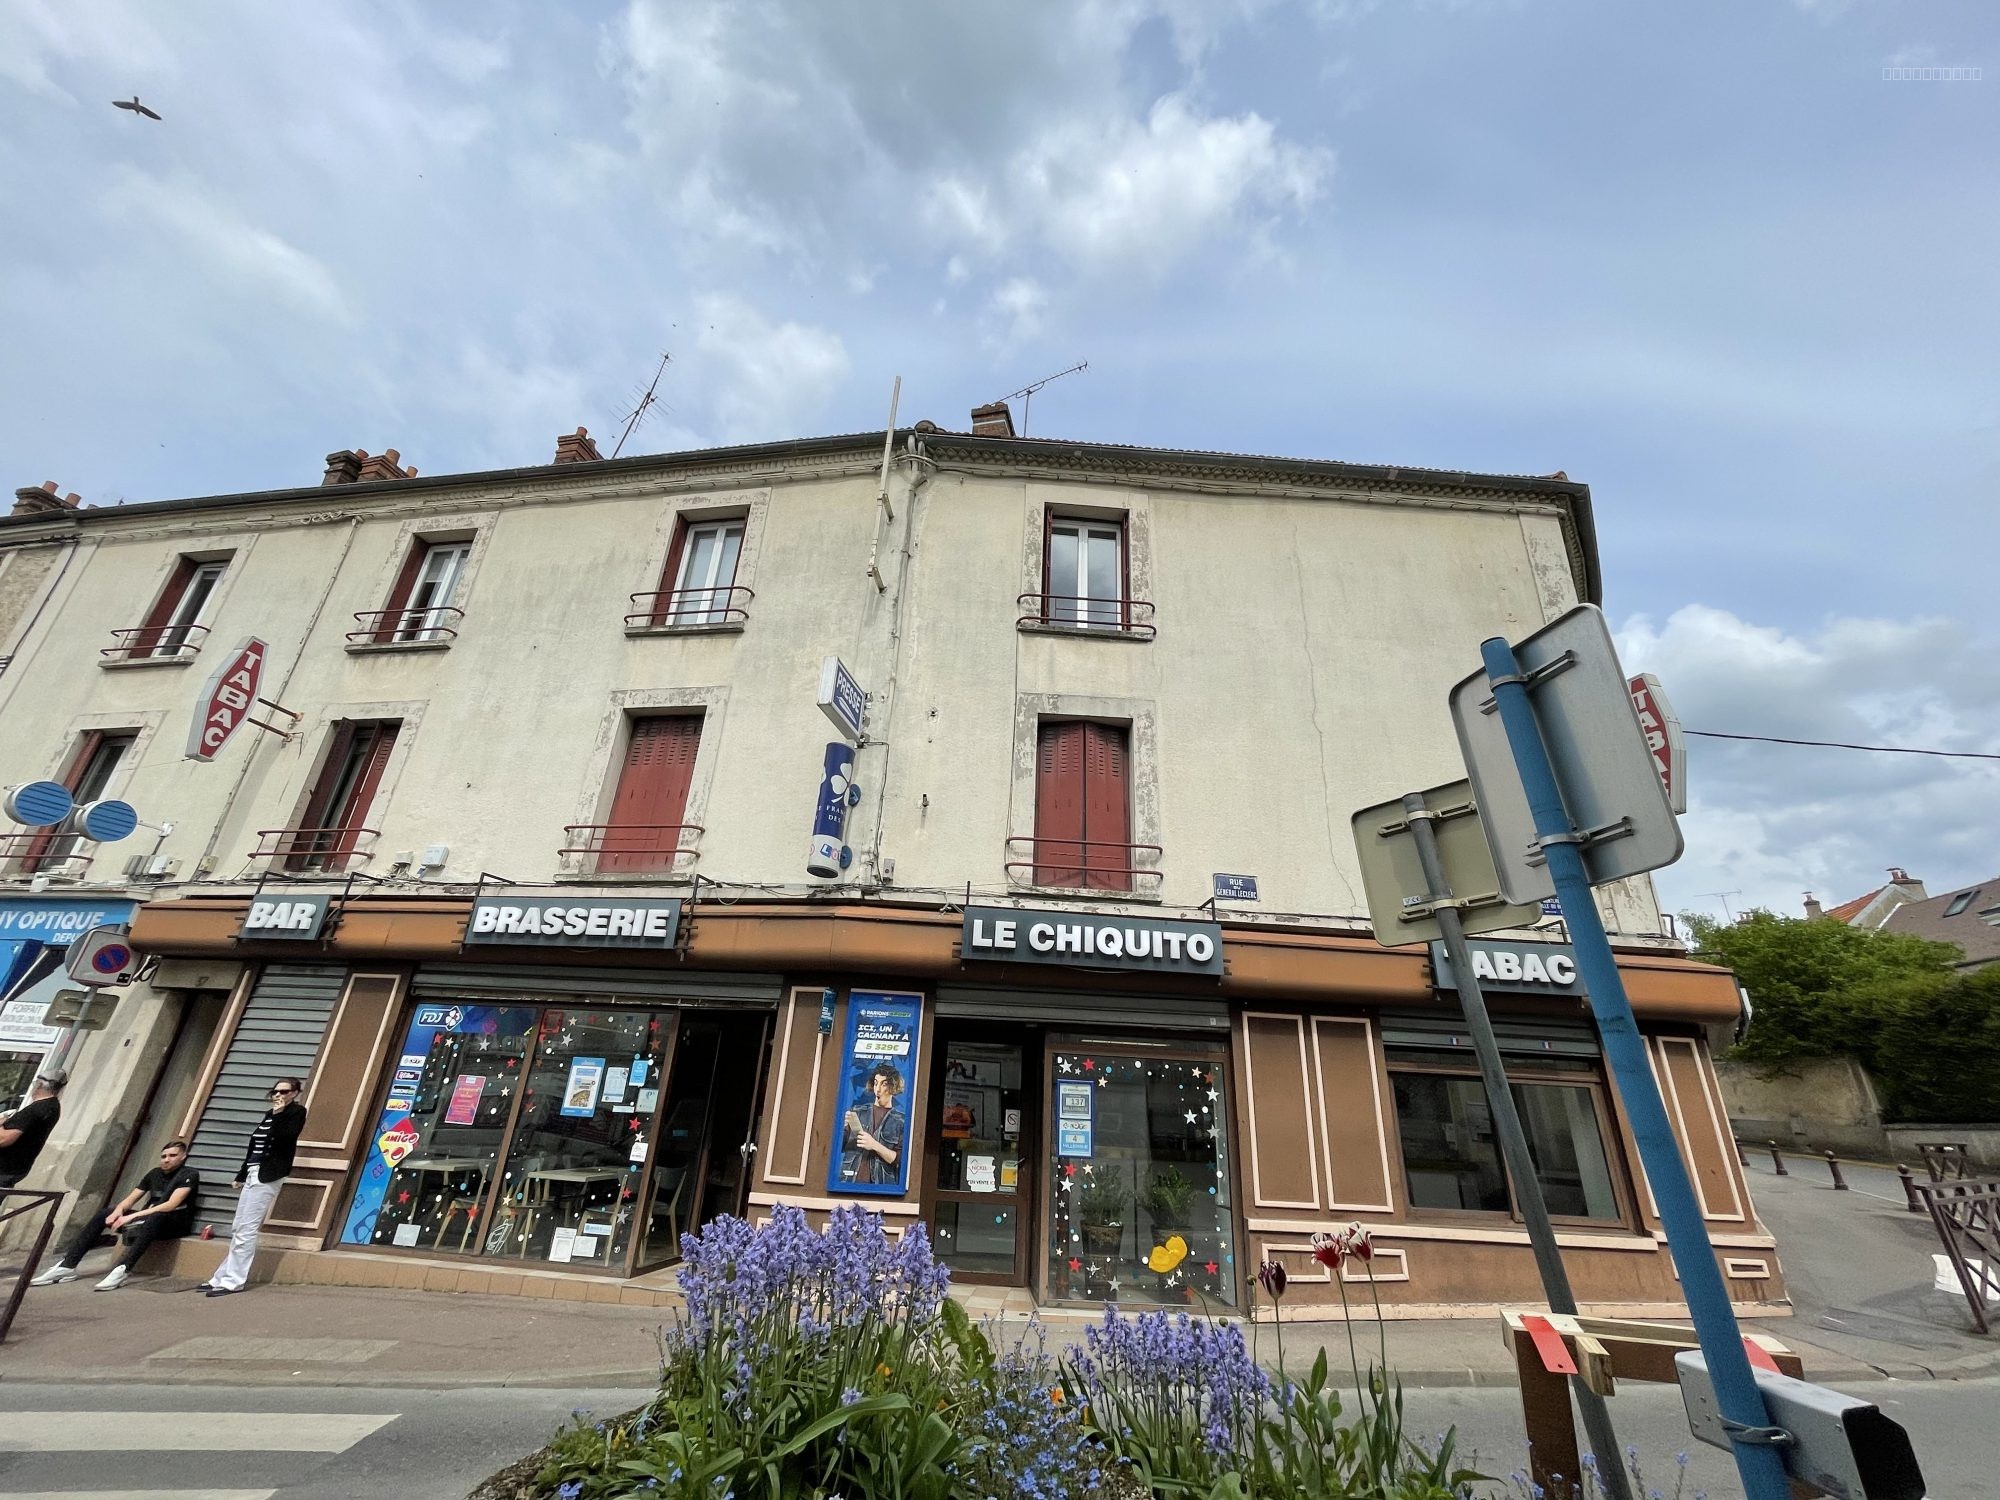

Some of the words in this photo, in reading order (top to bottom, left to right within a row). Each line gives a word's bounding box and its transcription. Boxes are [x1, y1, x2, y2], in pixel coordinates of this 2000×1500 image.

[204, 650, 261, 747] TABAC
[836, 671, 861, 714] PRESSE
[1237, 890, 1257, 899] LECLERC
[18, 910, 106, 930] OPTIQUE
[245, 902, 317, 930] BAR
[473, 906, 670, 938] BRASSERIE
[972, 919, 1017, 949] LE
[1029, 922, 1214, 962] CHIQUITO
[420, 1012, 443, 1023] FDJ
[857, 1032, 900, 1040] GAGNANT
[858, 1024, 876, 1033] ICI,
[879, 1025, 893, 1033] UN
[1071, 1098, 1084, 1106] 137
[384, 1132, 419, 1144] AMIGO
